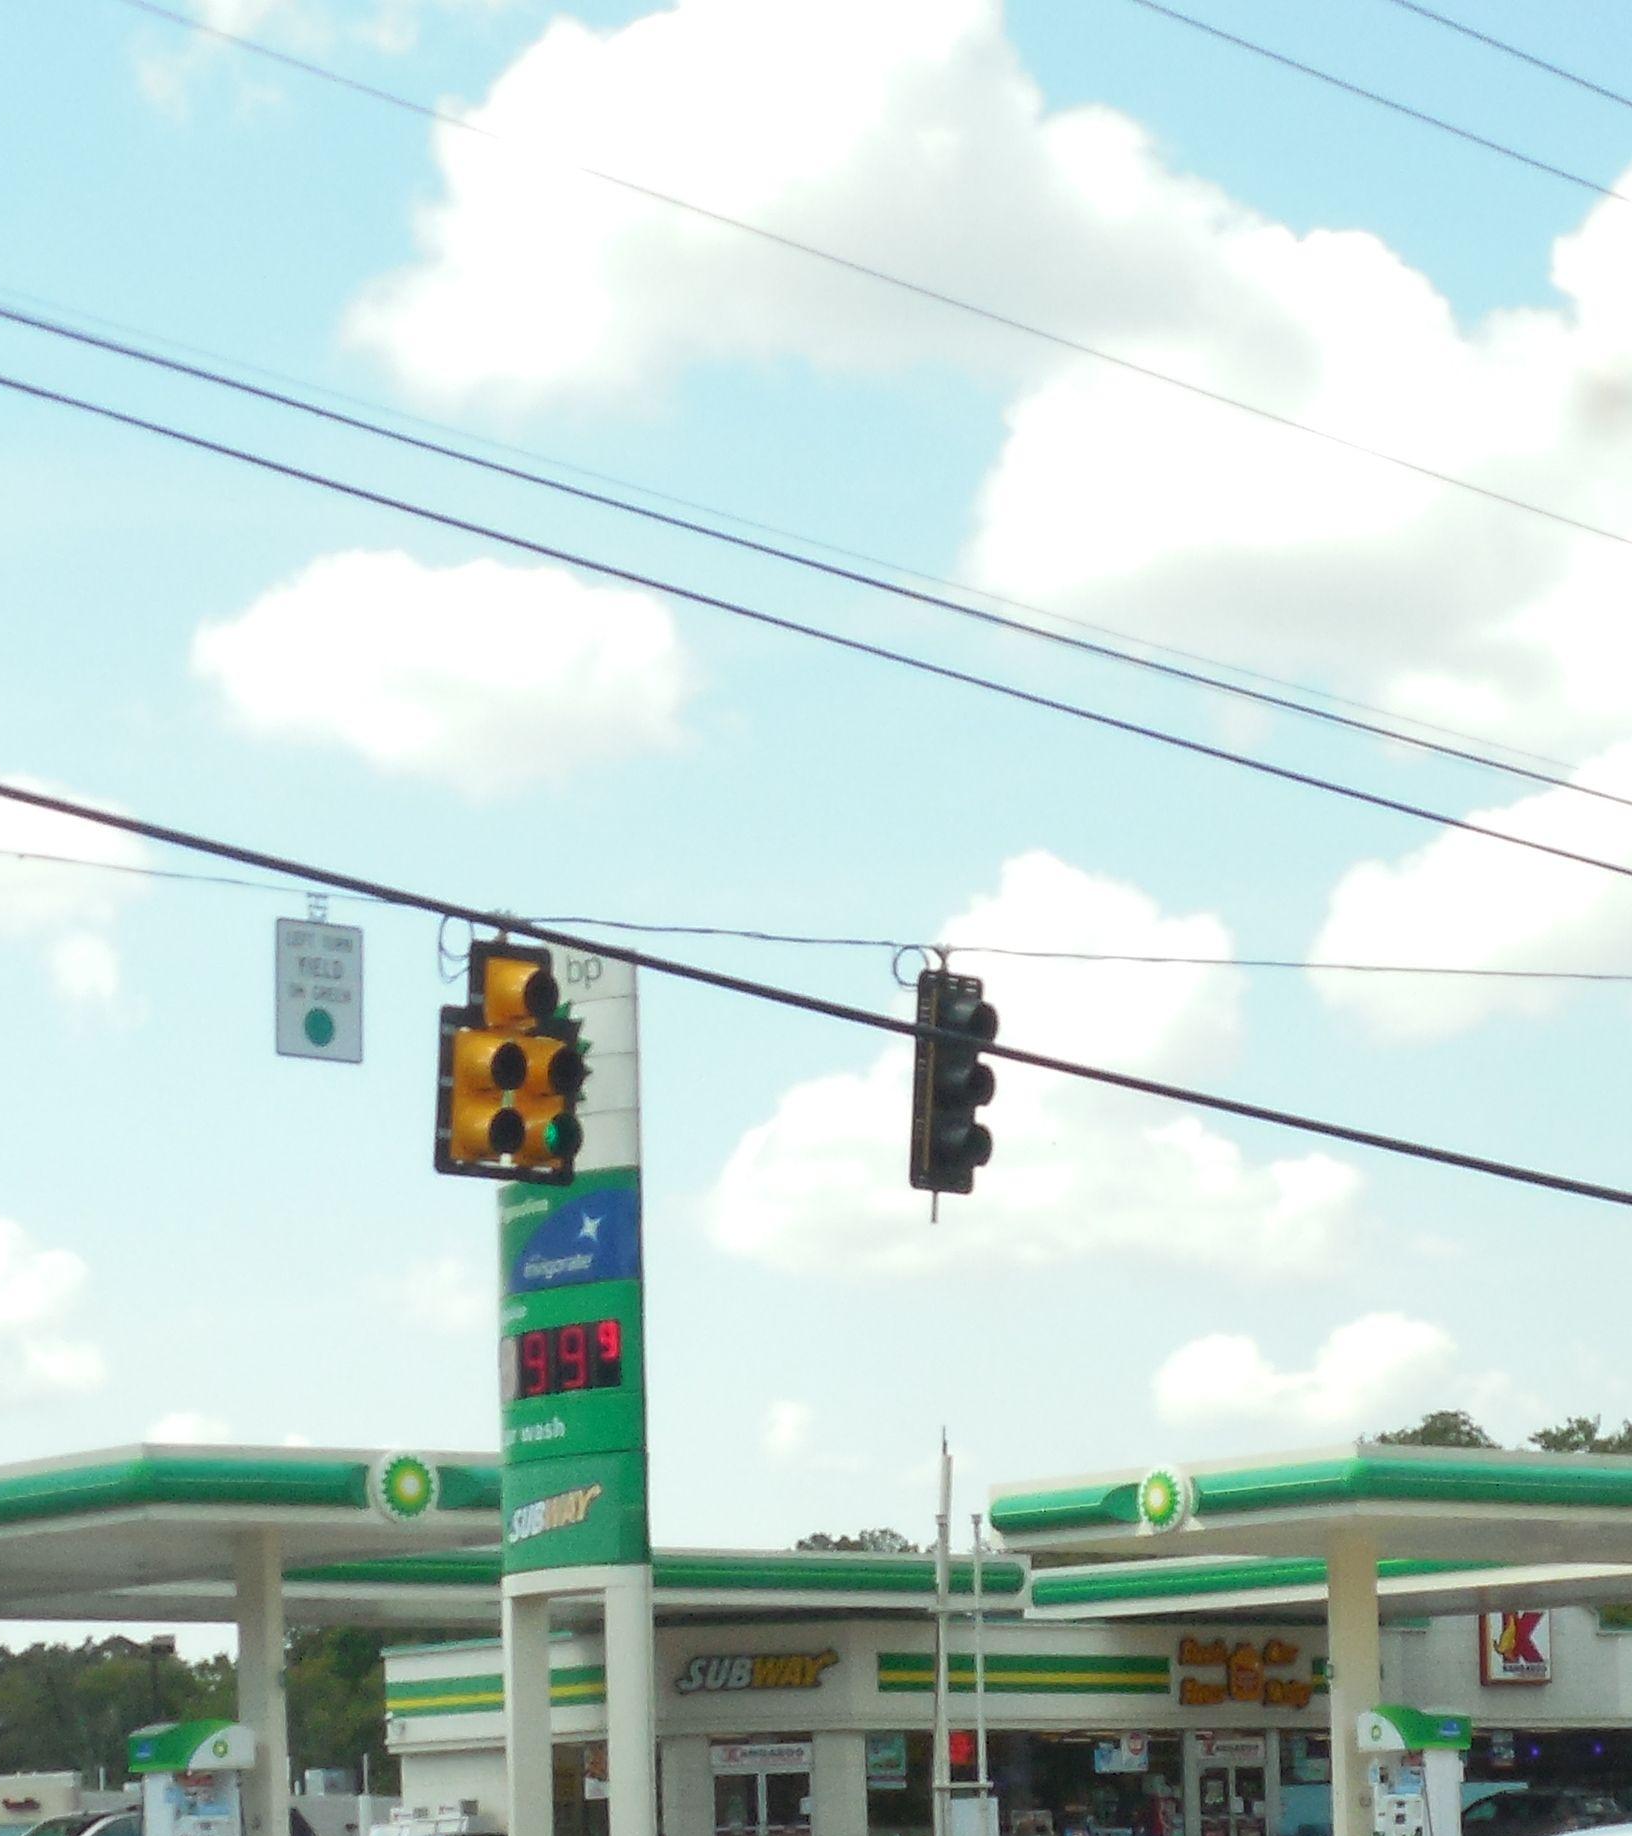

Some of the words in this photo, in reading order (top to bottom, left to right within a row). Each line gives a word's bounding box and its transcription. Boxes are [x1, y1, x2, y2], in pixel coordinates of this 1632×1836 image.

[297, 956, 344, 980] YIELD
[567, 953, 603, 990] bp
[521, 1416, 566, 1442] wash
[506, 1483, 602, 1544] SUBWAY
[675, 1648, 839, 1691] SUBWAY
